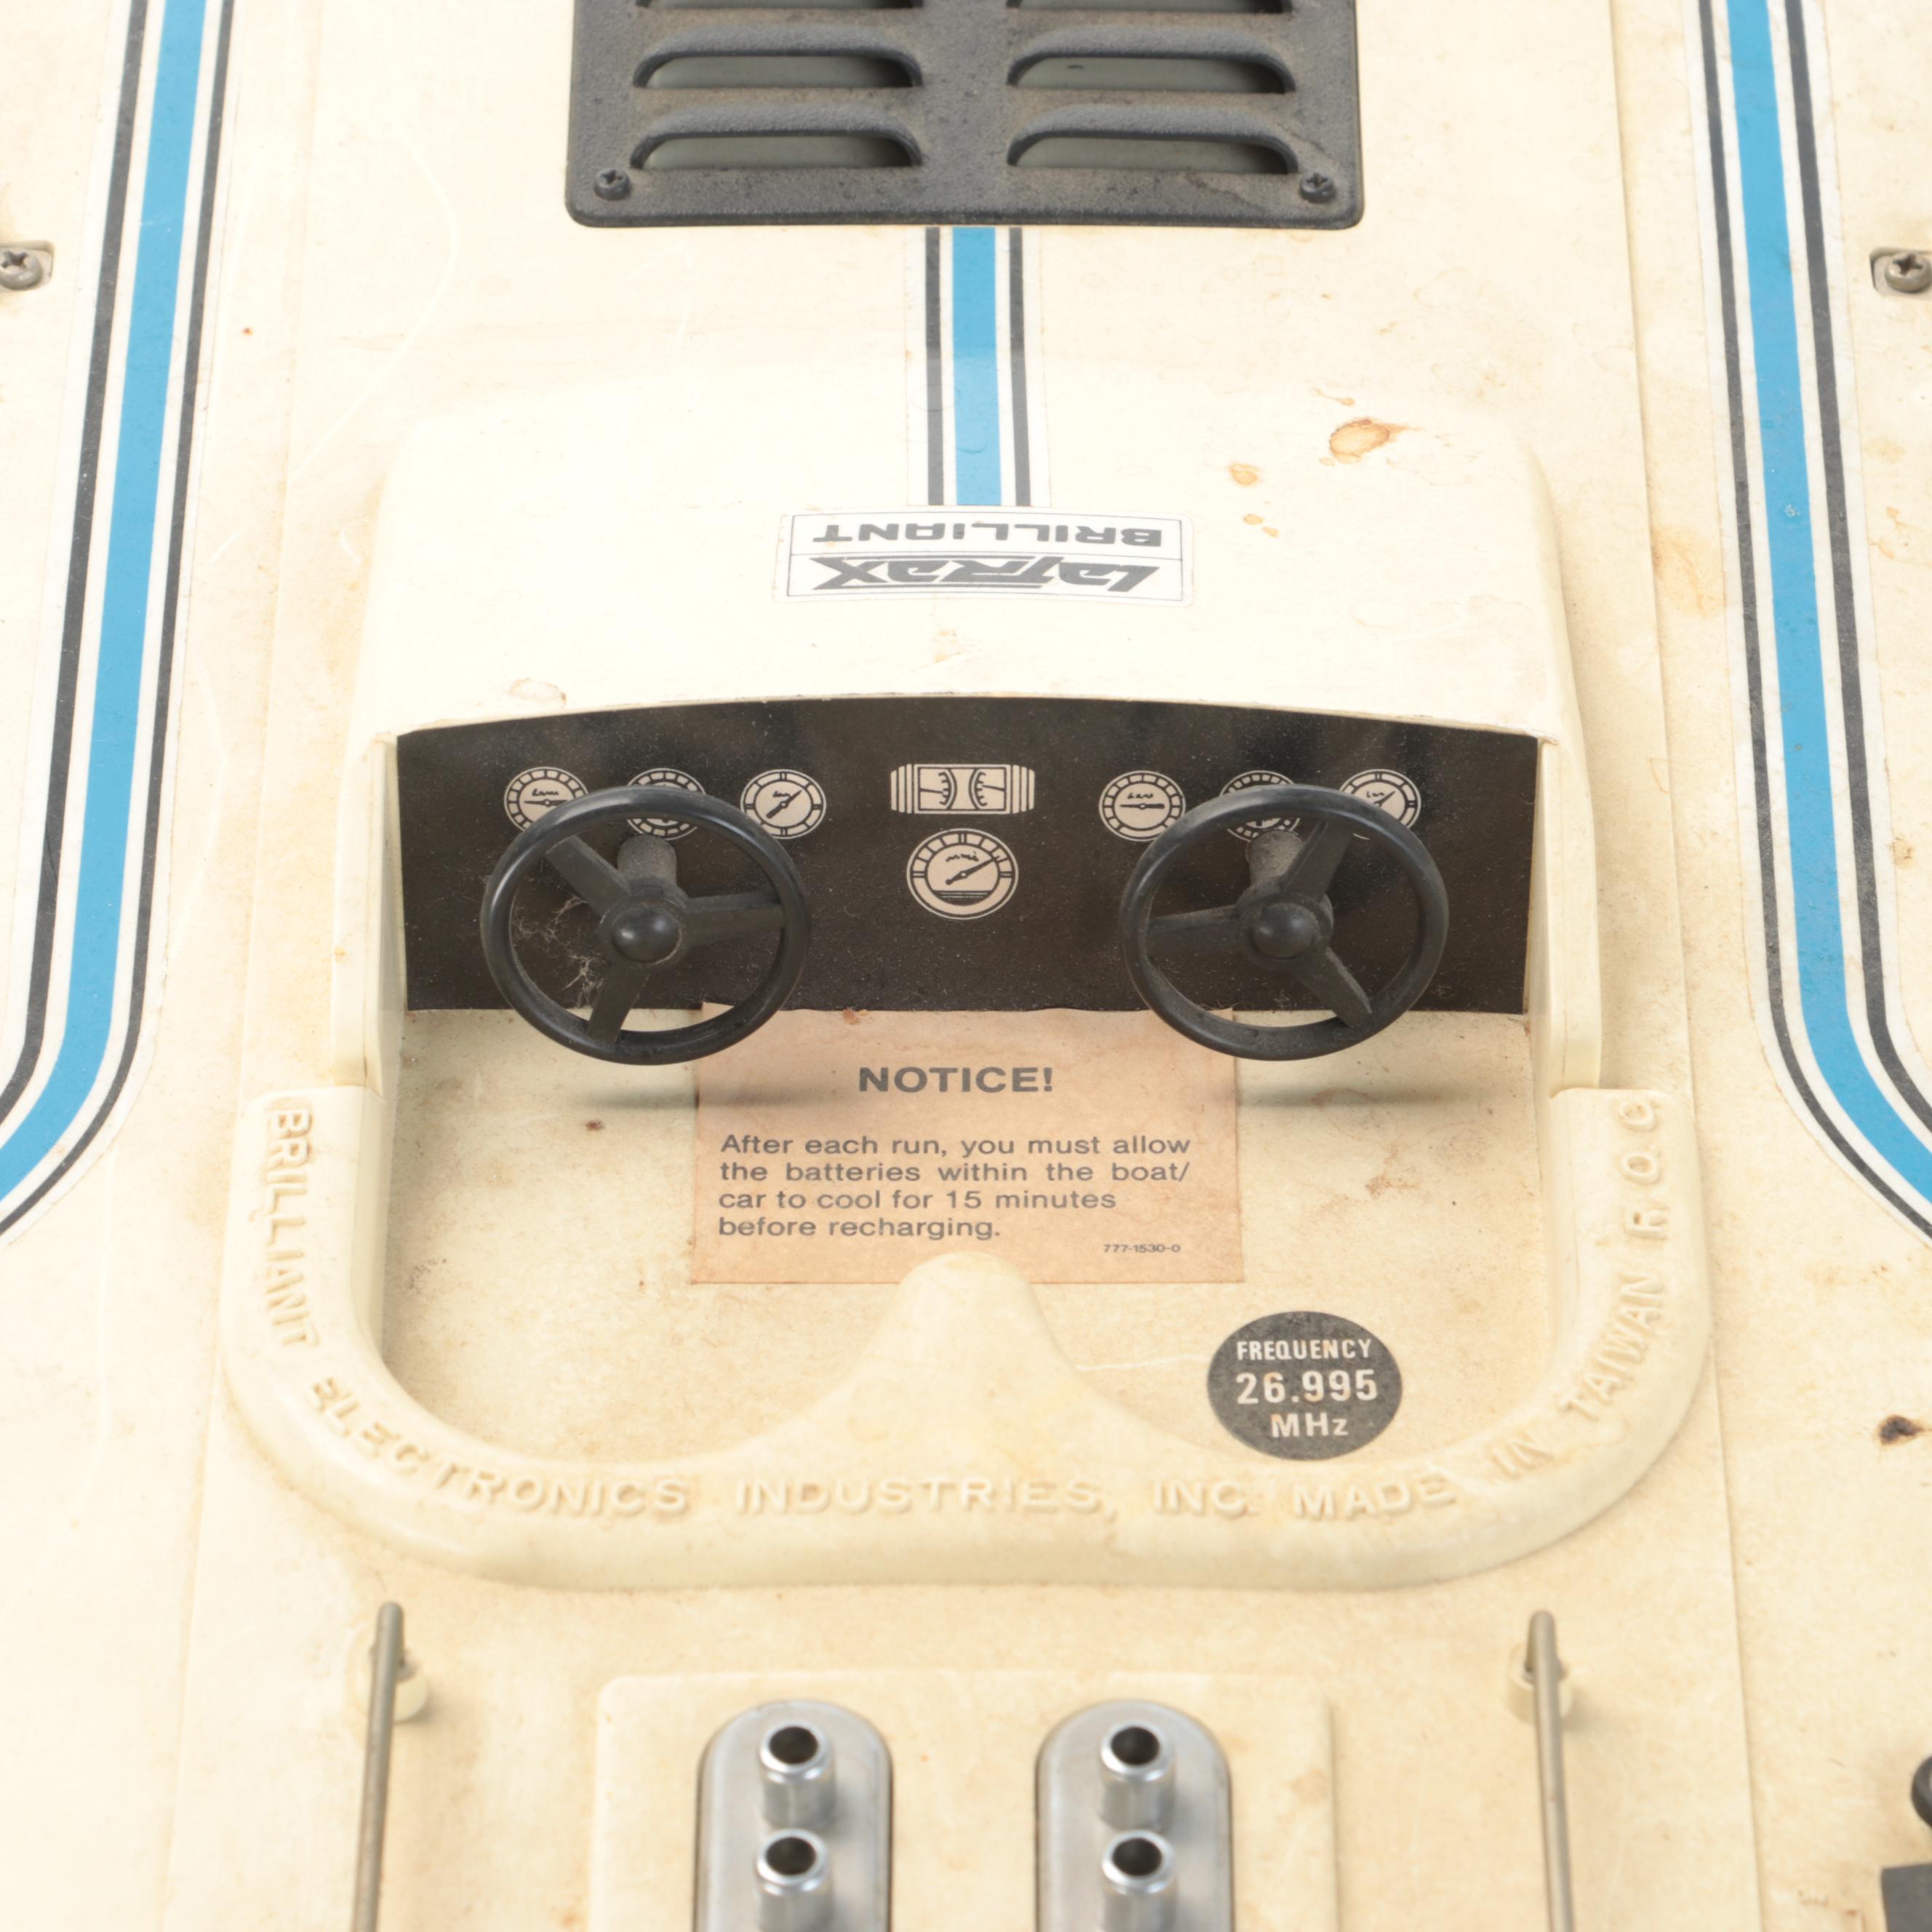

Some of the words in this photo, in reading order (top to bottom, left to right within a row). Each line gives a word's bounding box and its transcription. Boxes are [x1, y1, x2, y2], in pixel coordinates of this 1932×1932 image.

[812, 522, 1162, 547] BRILLIANT
[858, 1066, 1053, 1093] NOTICE!
[720, 1134, 794, 1154] After
[805, 1135, 878, 1154] each
[892, 1139, 947, 1157] run,
[961, 1139, 1015, 1158] you
[1028, 1136, 1101, 1154] must
[1112, 1135, 1191, 1154] allow
[720, 1162, 769, 1181] the
[786, 1162, 922, 1181] batteries
[938, 1162, 1028, 1181] within
[1045, 1162, 1094, 1181] the
[1111, 1162, 1191, 1182] boat/
[719, 1192, 767, 1209] car
[776, 1189, 807, 1209] to
[816, 1189, 881, 1209] cool
[892, 1189, 933, 1209] for
[946, 1190, 982, 1209] 15
[995, 1190, 1117, 1209] minutes
[719, 1216, 816, 1237] before
[829, 1216, 1000, 1241] recharging.
[264, 1106, 319, 1347] BRILLIANT
[308, 1376, 690, 1519] ELECTRONICS
[733, 1475, 1118, 1524] INDUSTRIES,
[1292, 1466, 1457, 1520] MADE
[1491, 1430, 1557, 1480] IN
[1557, 1272, 1664, 1421] TAIWAN
[1237, 1338, 1371, 1360] FREQUENCY
[1235, 1368, 1378, 1405] 26.995
[1270, 1411, 1349, 1438] MHz
